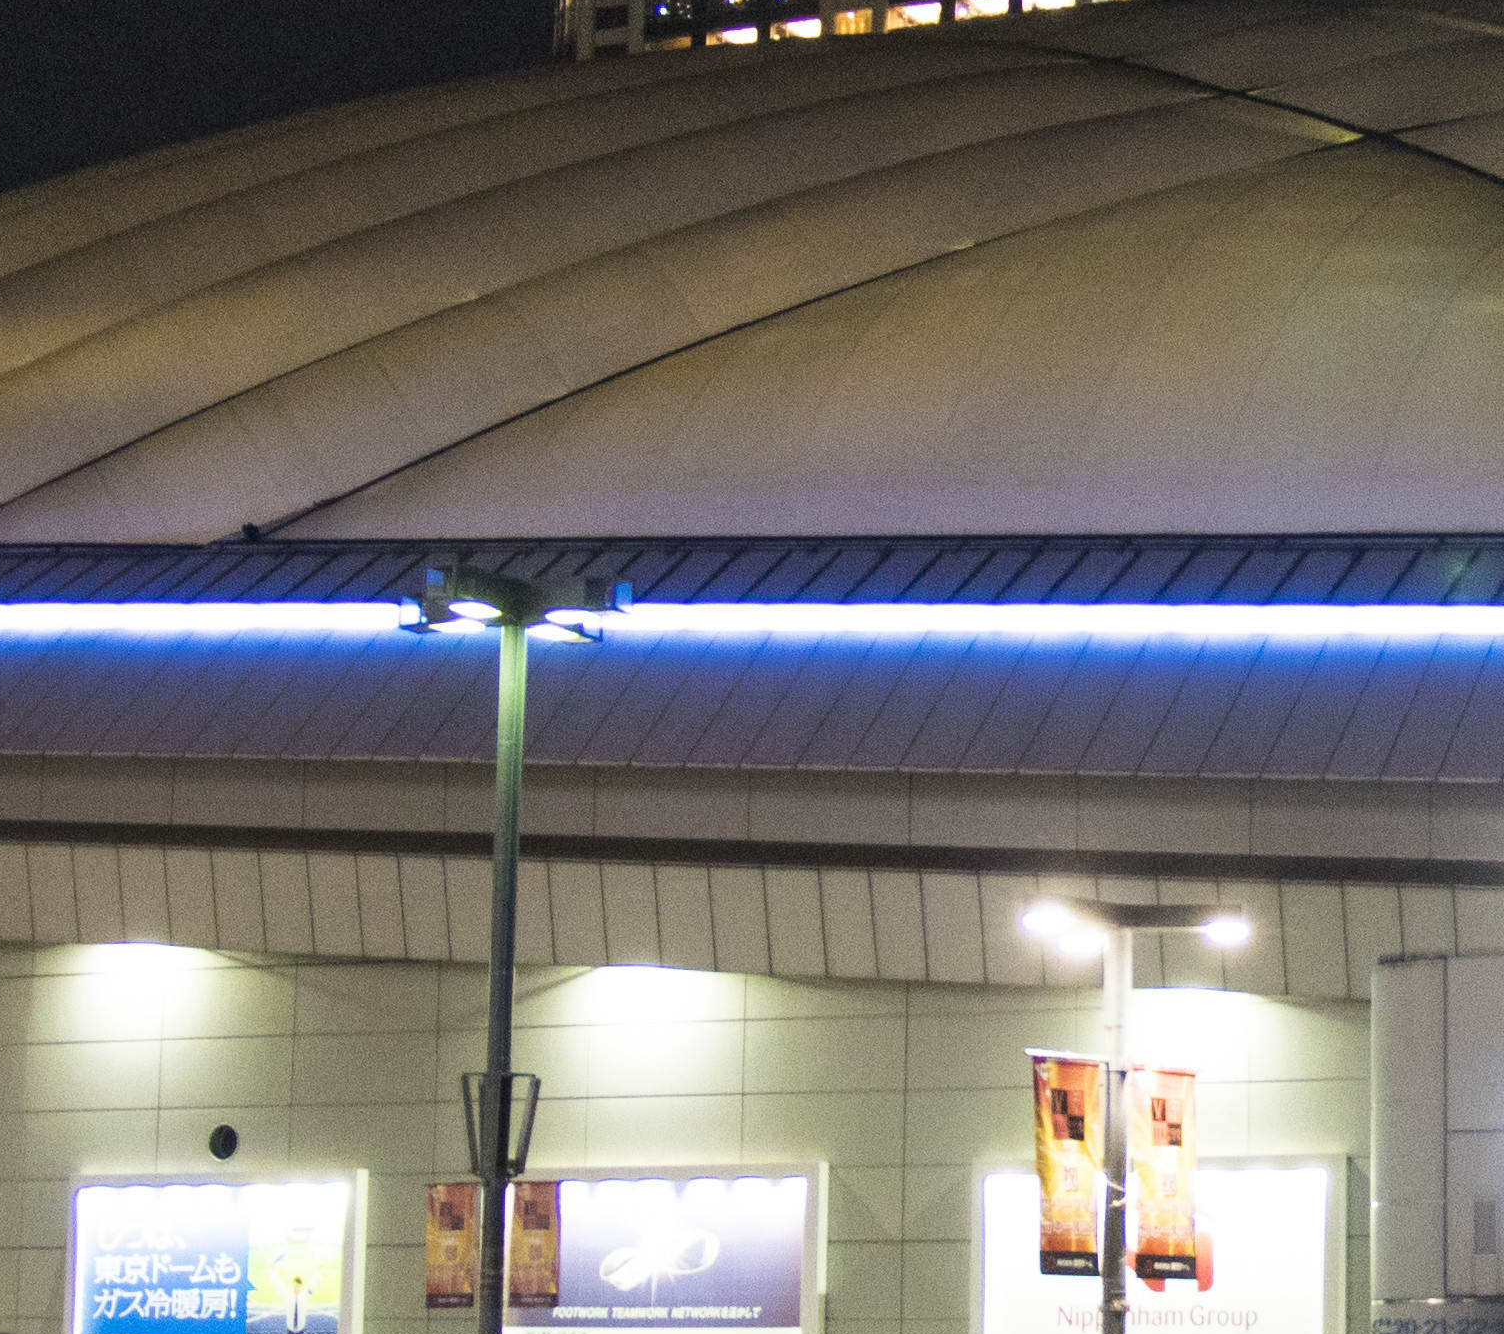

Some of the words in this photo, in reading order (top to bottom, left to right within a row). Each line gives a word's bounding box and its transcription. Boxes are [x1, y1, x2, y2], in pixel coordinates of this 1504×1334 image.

[93, 1252, 242, 1285] 東京ドームも
[93, 1287, 238, 1319] ガス冷暖房!
[1057, 1305, 1184, 1332] Nippnham
[1189, 1304, 1259, 1331] Group
